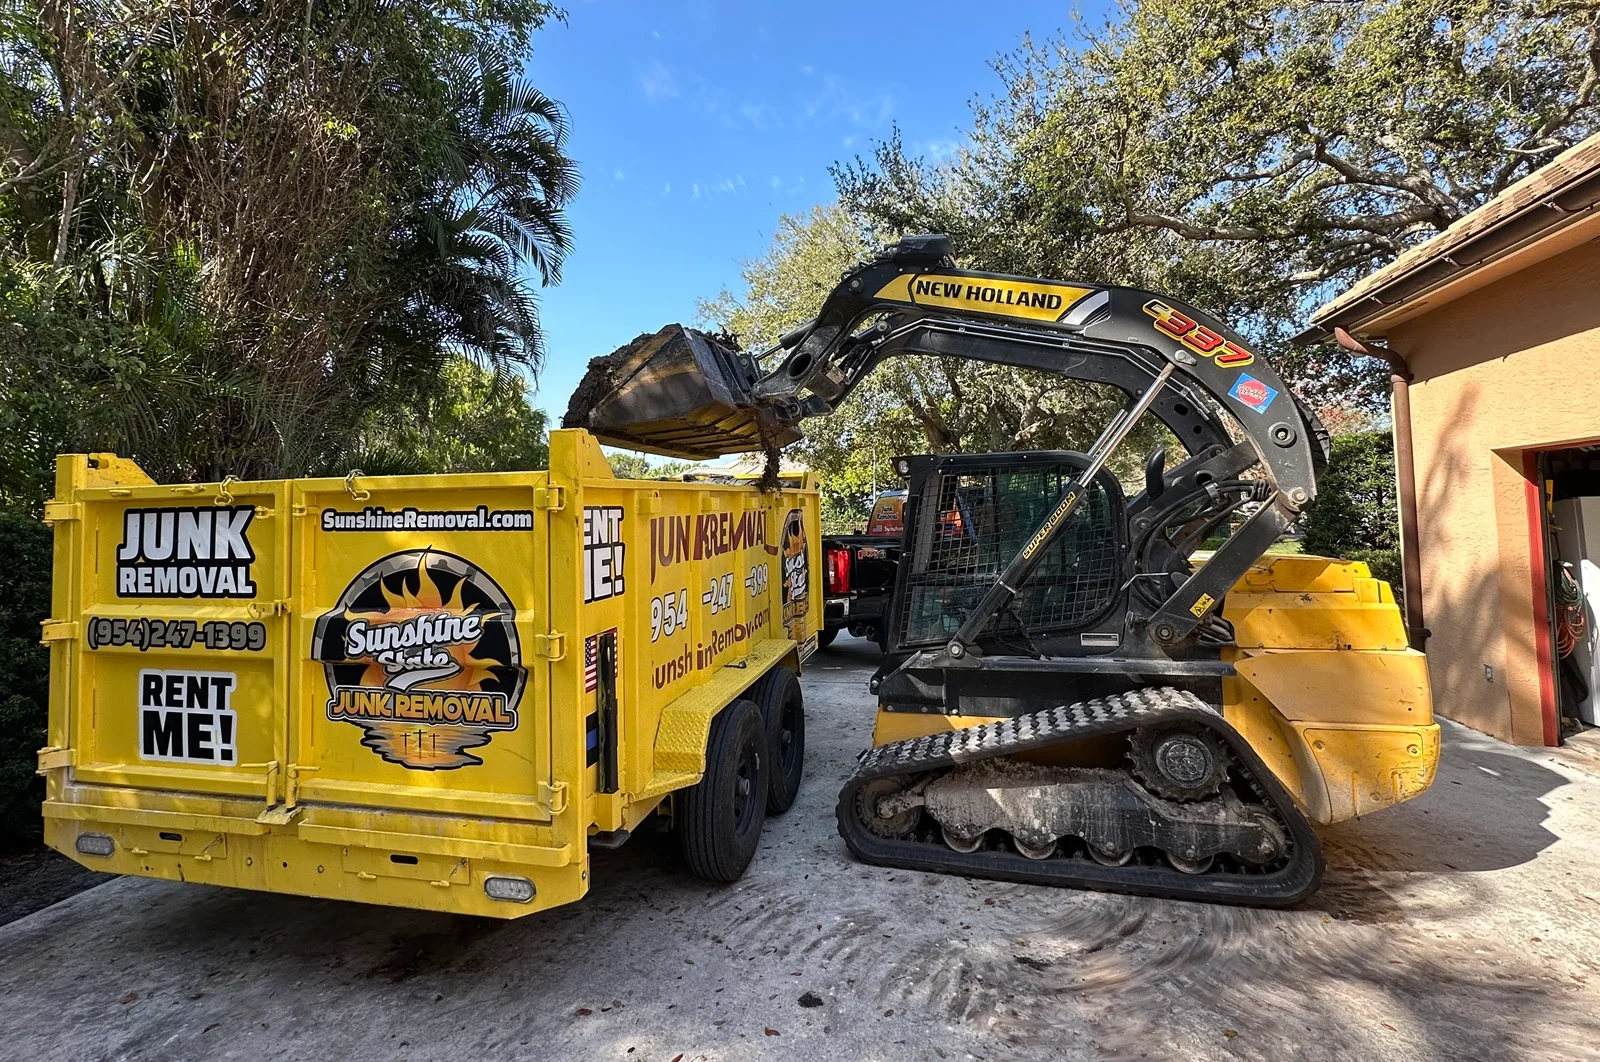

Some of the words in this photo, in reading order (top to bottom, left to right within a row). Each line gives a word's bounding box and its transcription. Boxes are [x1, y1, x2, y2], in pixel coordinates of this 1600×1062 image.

[916, 280, 962, 299] NEW
[966, 285, 1063, 310] HOLLAND
[119, 508, 254, 562] JUNK
[322, 507, 533, 530] SunshineRemoval.com
[583, 506, 624, 546] ENT
[884, 524, 904, 532] Sunshin
[1023, 521, 1052, 559] SUPER
[1049, 491, 1076, 525] BOOM
[119, 565, 254, 596] REMOVAL
[88, 617, 266, 651] (954)247-1399
[347, 612, 484, 656] Sunshine
[377, 647, 451, 674] State
[142, 674, 233, 711] RENT
[332, 690, 393, 720] JUNK
[395, 693, 511, 724] REMOVAL
[142, 710, 234, 761] ME!
